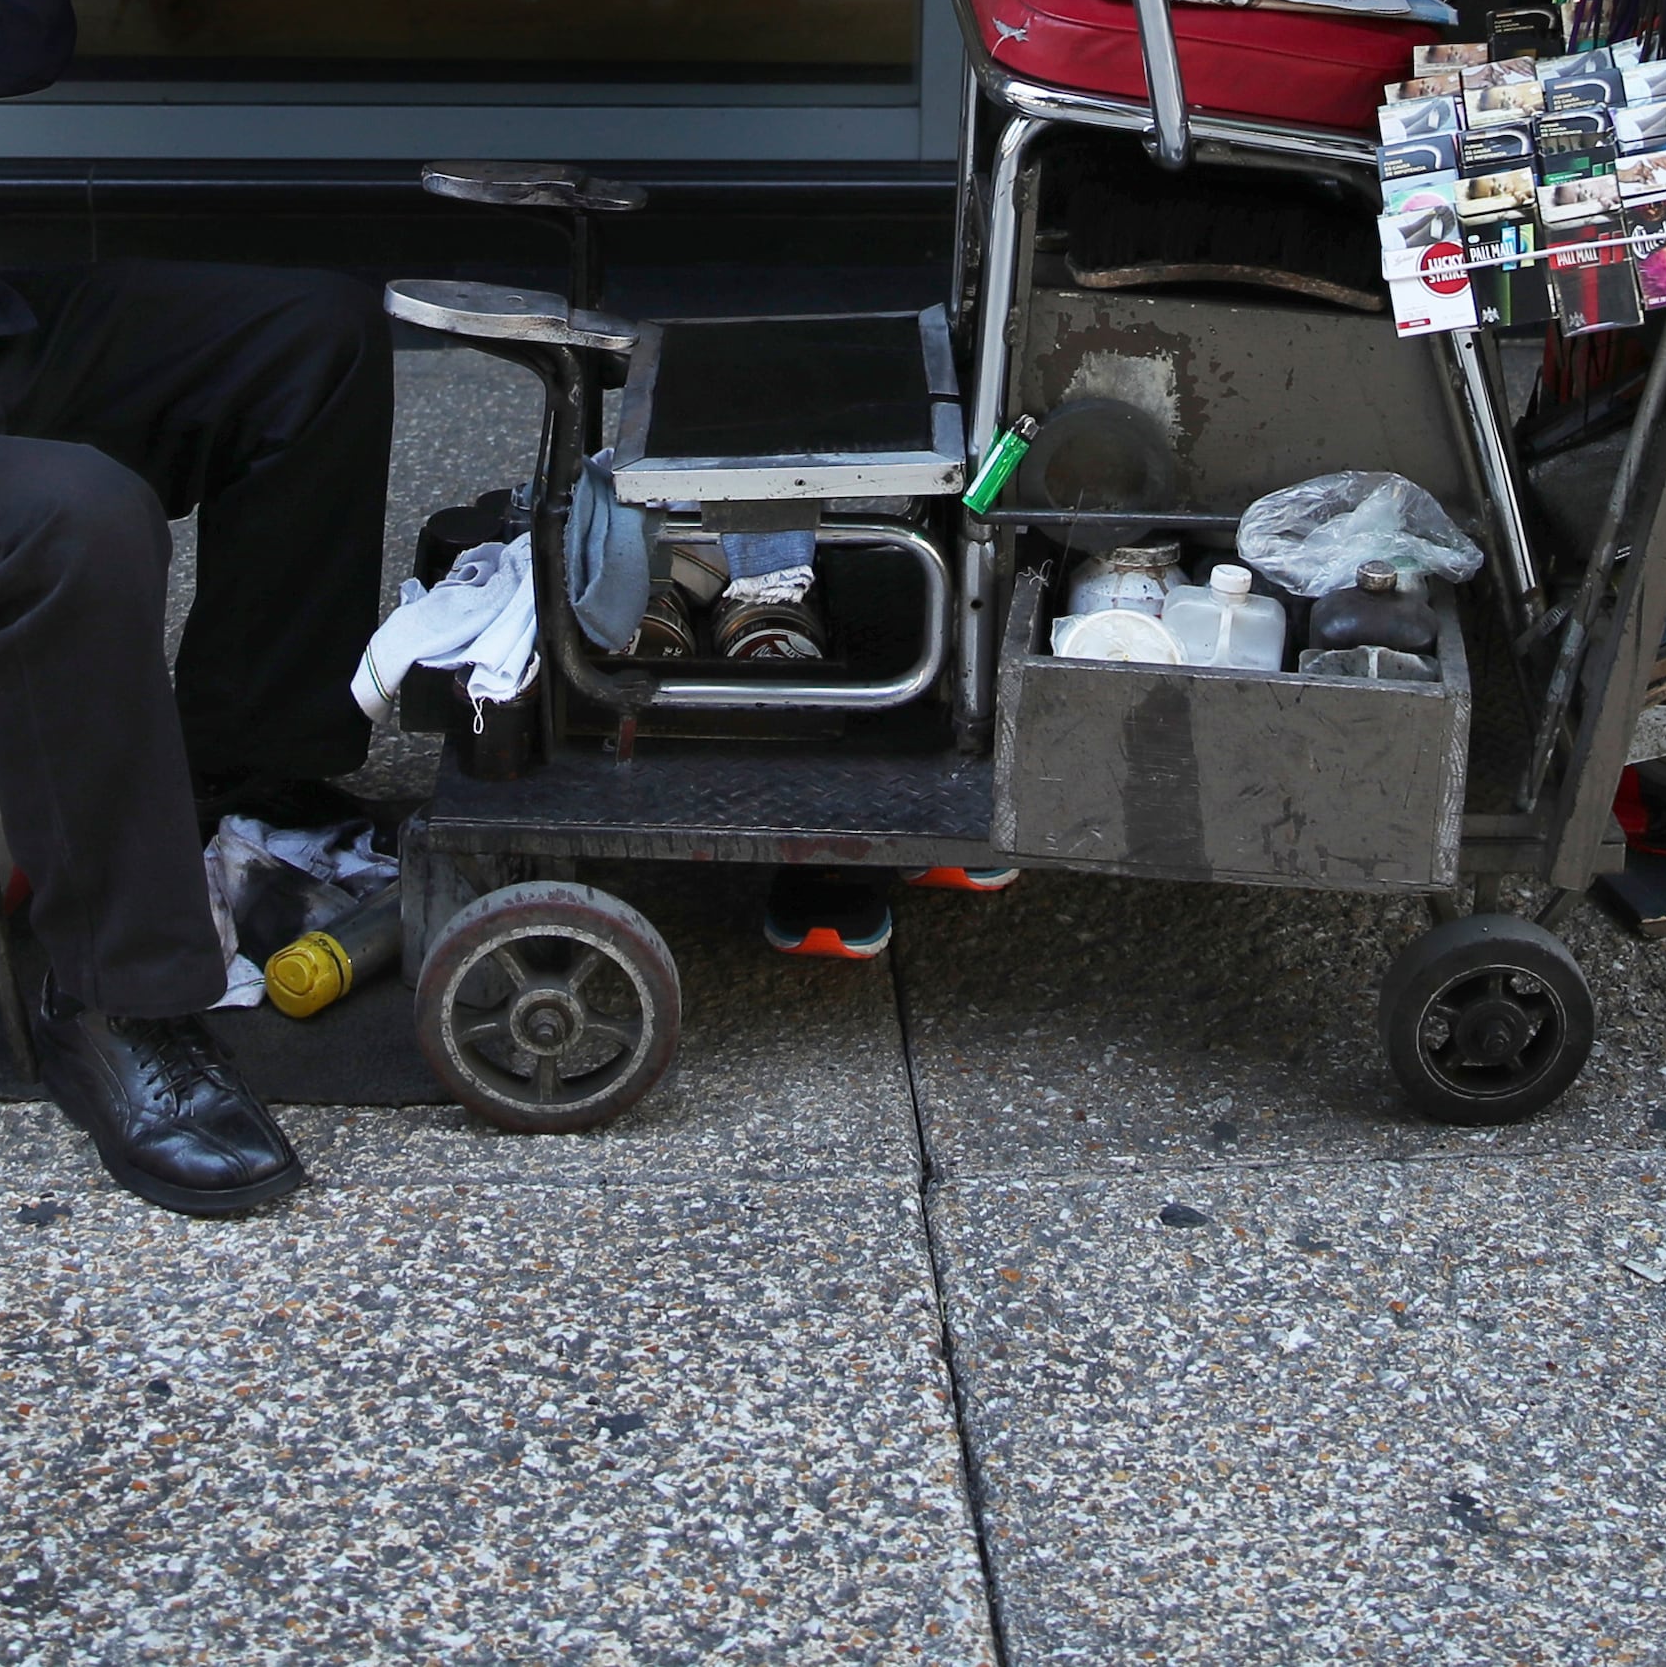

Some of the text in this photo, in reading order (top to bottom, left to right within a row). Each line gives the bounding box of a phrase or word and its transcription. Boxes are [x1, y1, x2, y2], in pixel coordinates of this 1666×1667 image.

[1469, 241, 1515, 262] PALL MALL
[1556, 246, 1599, 267] PALL MALL
[1427, 253, 1465, 272] LUCKY
[1428, 270, 1468, 284] STRIKE
